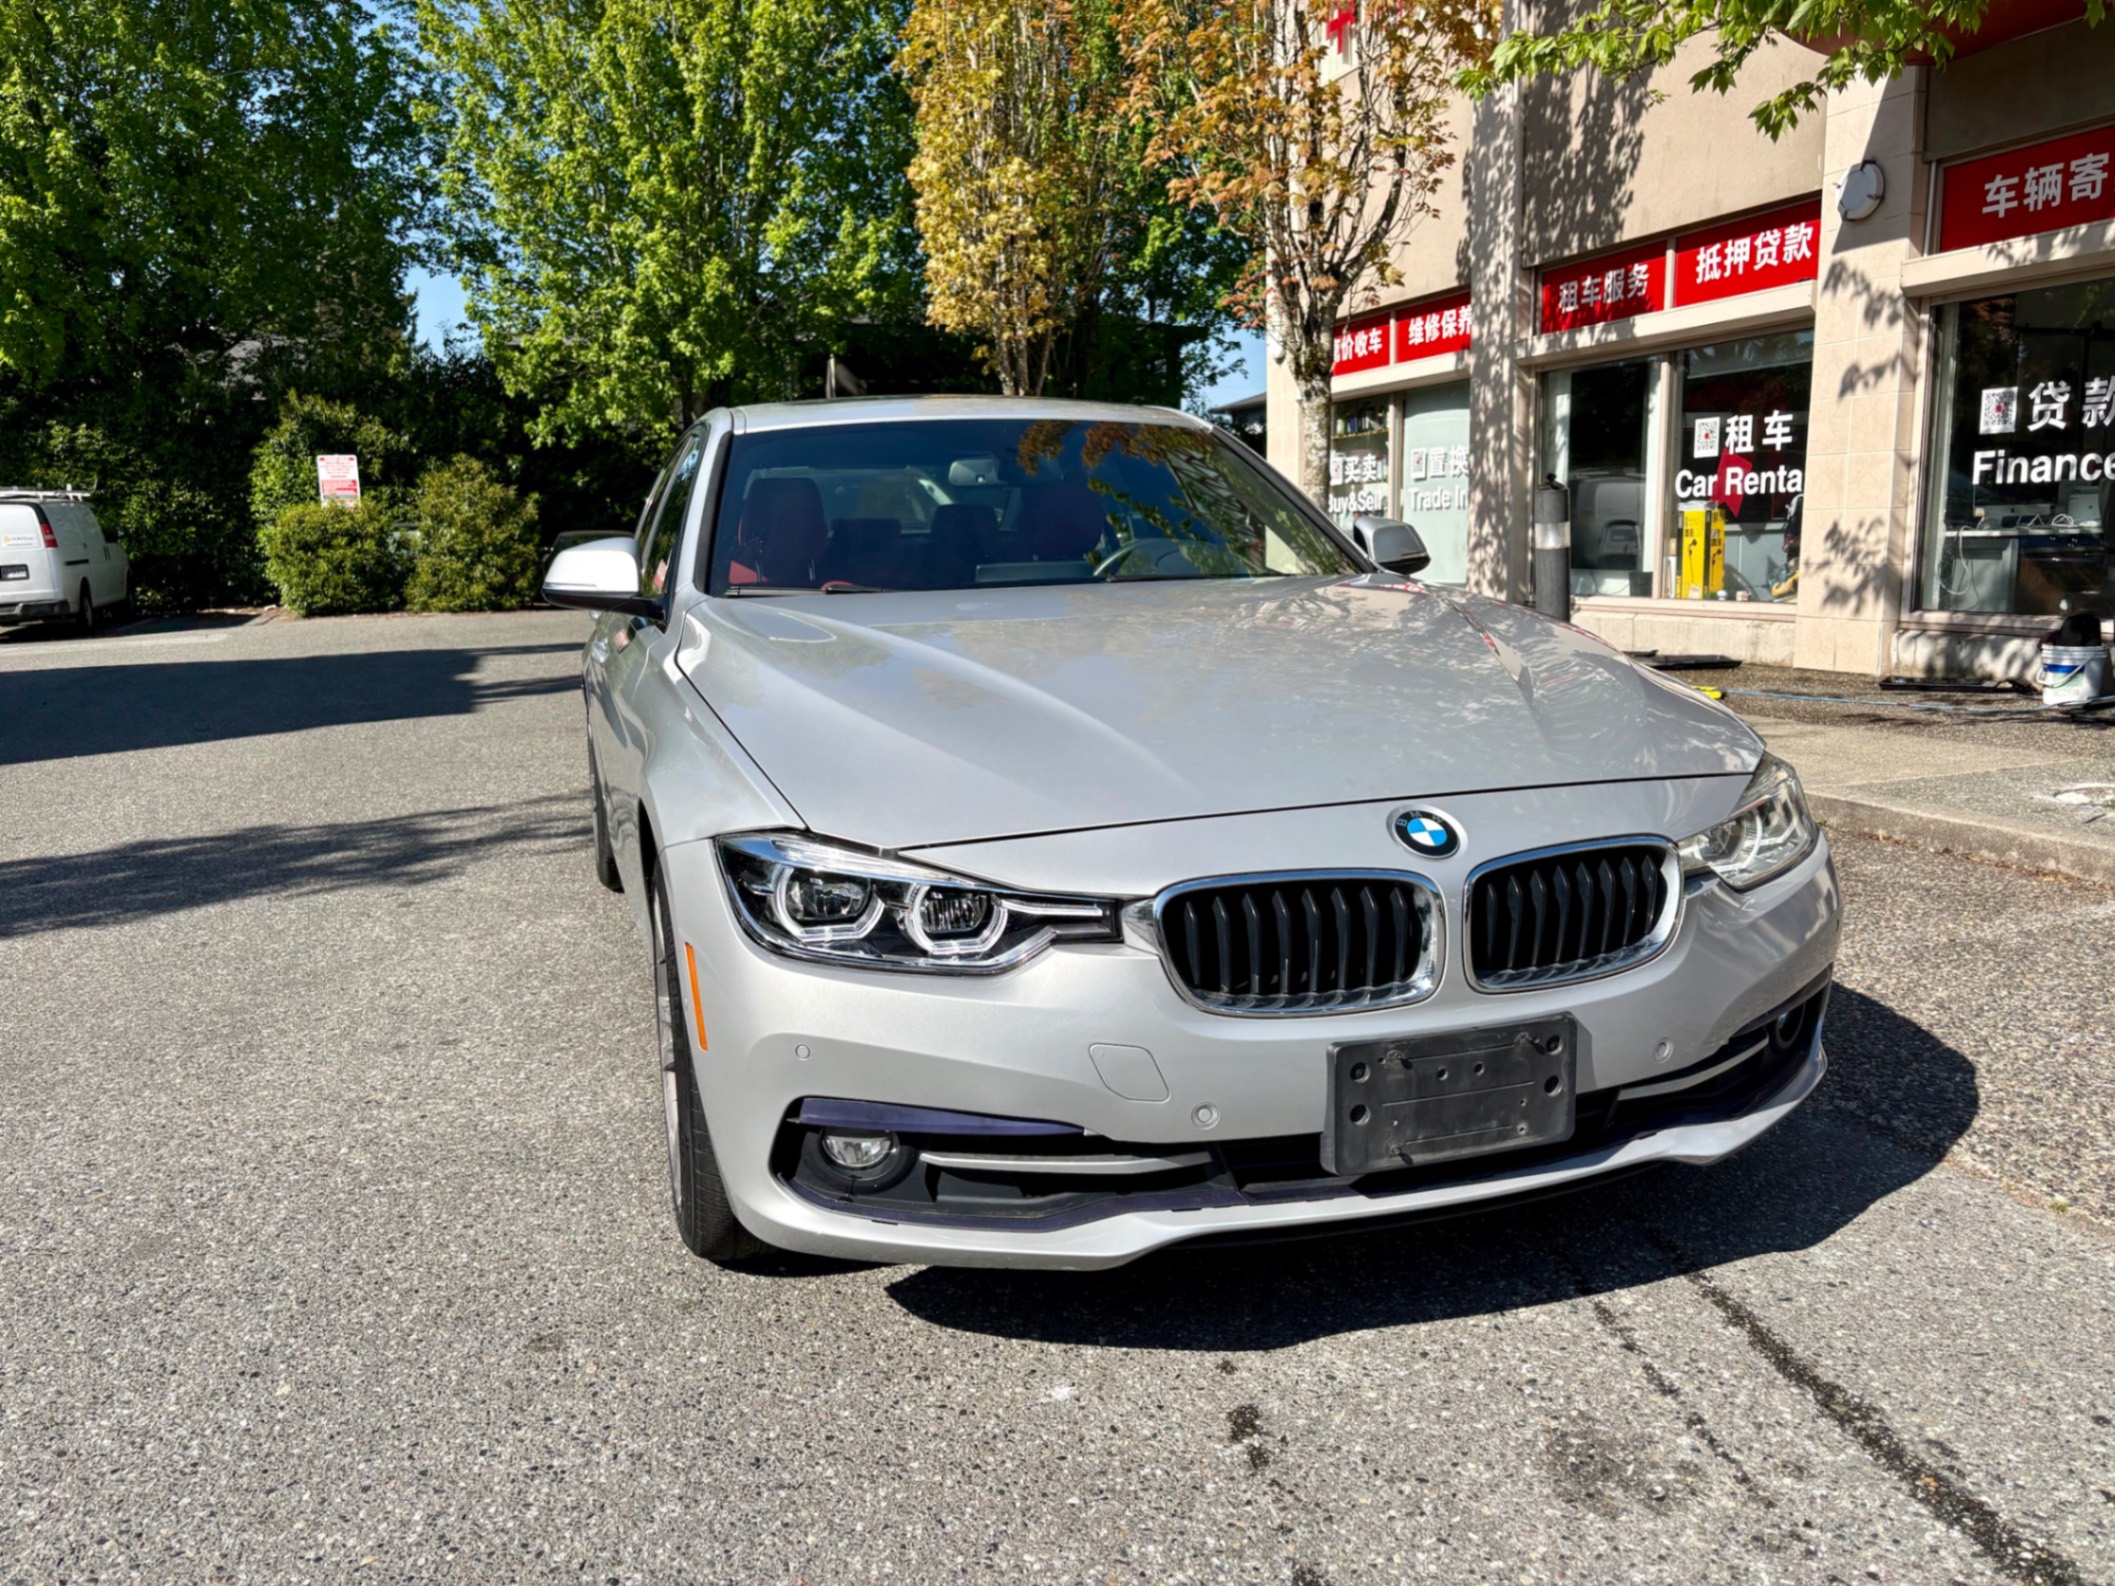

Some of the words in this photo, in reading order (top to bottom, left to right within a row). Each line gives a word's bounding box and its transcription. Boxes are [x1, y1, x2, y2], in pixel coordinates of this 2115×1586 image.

[1981, 152, 2115, 219] 车辆寄
[1695, 221, 1813, 285] 抵押贷款
[1558, 262, 1650, 314] 租车服务
[1408, 304, 1471, 346] 维修保养
[2027, 375, 2115, 432] 贷款
[1725, 410, 1793, 455] 租车
[1344, 453, 1377, 484] 买卖
[1428, 444, 1469, 478] 置换
[1972, 449, 2115, 485] Finance
[1409, 487, 1451, 512] Trade
[1455, 484, 1468, 511] In
[1675, 469, 1718, 498] Car
[1725, 465, 1803, 496] Renta
[1397, 810, 1444, 827] BMW
